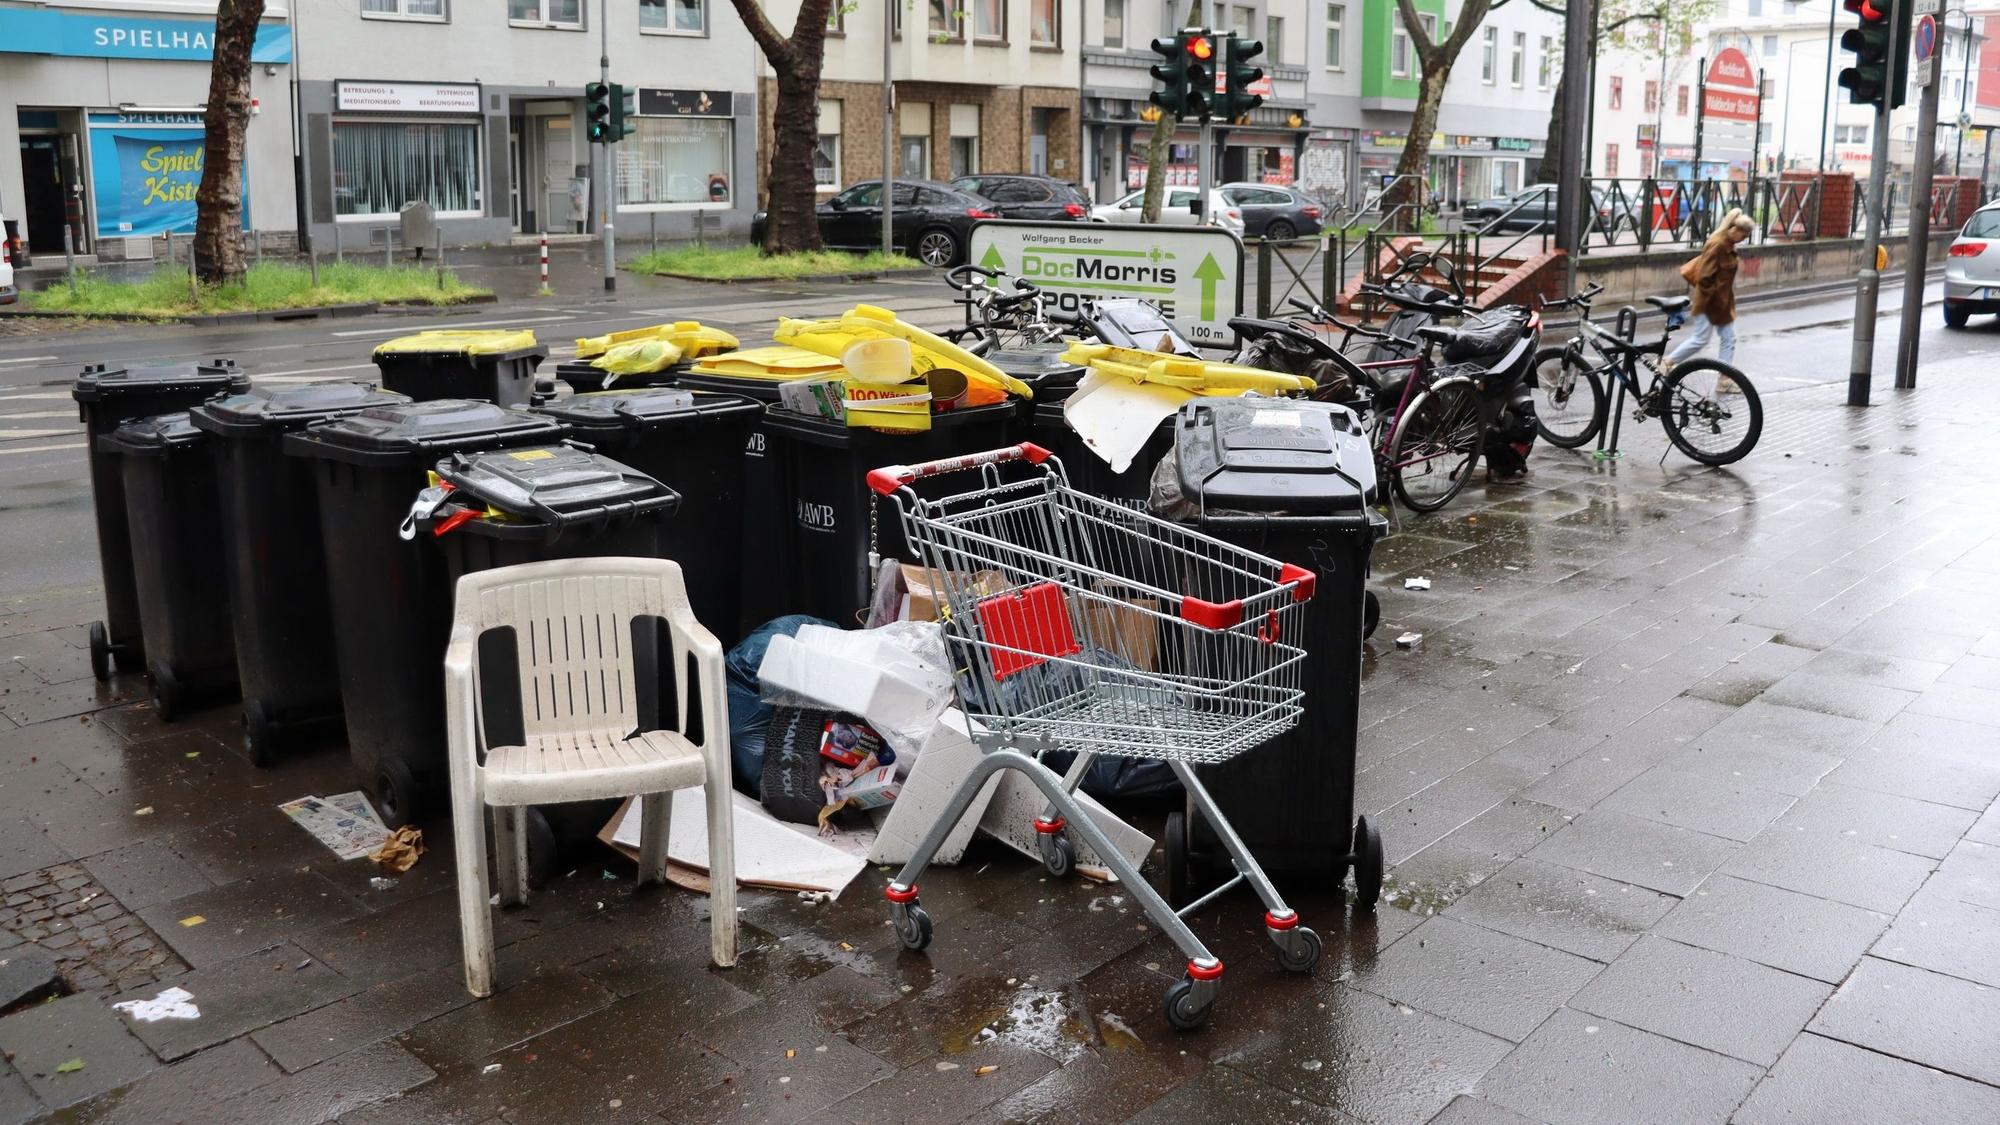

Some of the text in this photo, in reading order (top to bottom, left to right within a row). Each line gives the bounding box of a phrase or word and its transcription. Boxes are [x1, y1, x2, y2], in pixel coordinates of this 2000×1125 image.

[95, 28, 215, 49] SPIELHA
[343, 87, 388, 95] BETREUUNGS-
[344, 97, 401, 105] MEDIATIONSBÜRO
[140, 146, 203, 176] Spiel
[1022, 234, 1104, 245] Wolfgang Becker
[1022, 254, 1176, 284] DocMorris
[1190, 326, 1224, 338] 100 m
[973, 453, 999, 464] NORMA
[935, 460, 961, 472] NORMA
[804, 502, 836, 527] AWB
[780, 708, 801, 798] THANK YOU
